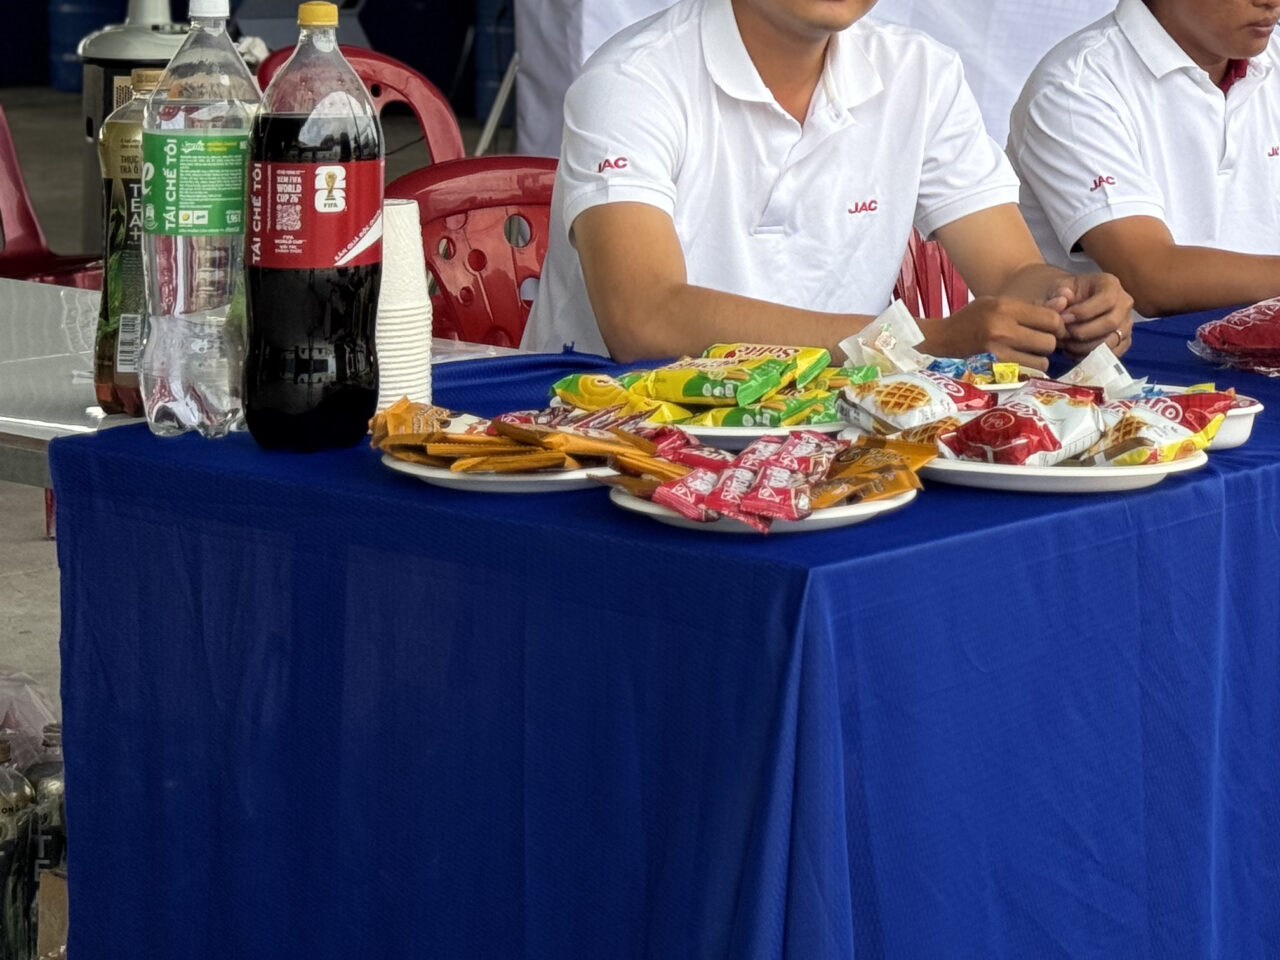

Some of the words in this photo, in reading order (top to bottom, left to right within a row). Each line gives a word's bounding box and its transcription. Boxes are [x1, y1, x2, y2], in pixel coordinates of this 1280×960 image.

[163, 139, 177, 166] TÔI
[162, 168, 177, 202] CHẾ
[252, 163, 263, 192] TÔI
[1090, 175, 1116, 192] JAC
[276, 184, 302, 193] WORLD
[276, 194, 290, 203] CUP
[848, 200, 879, 215] JAC
[163, 206, 177, 230] TÁI
